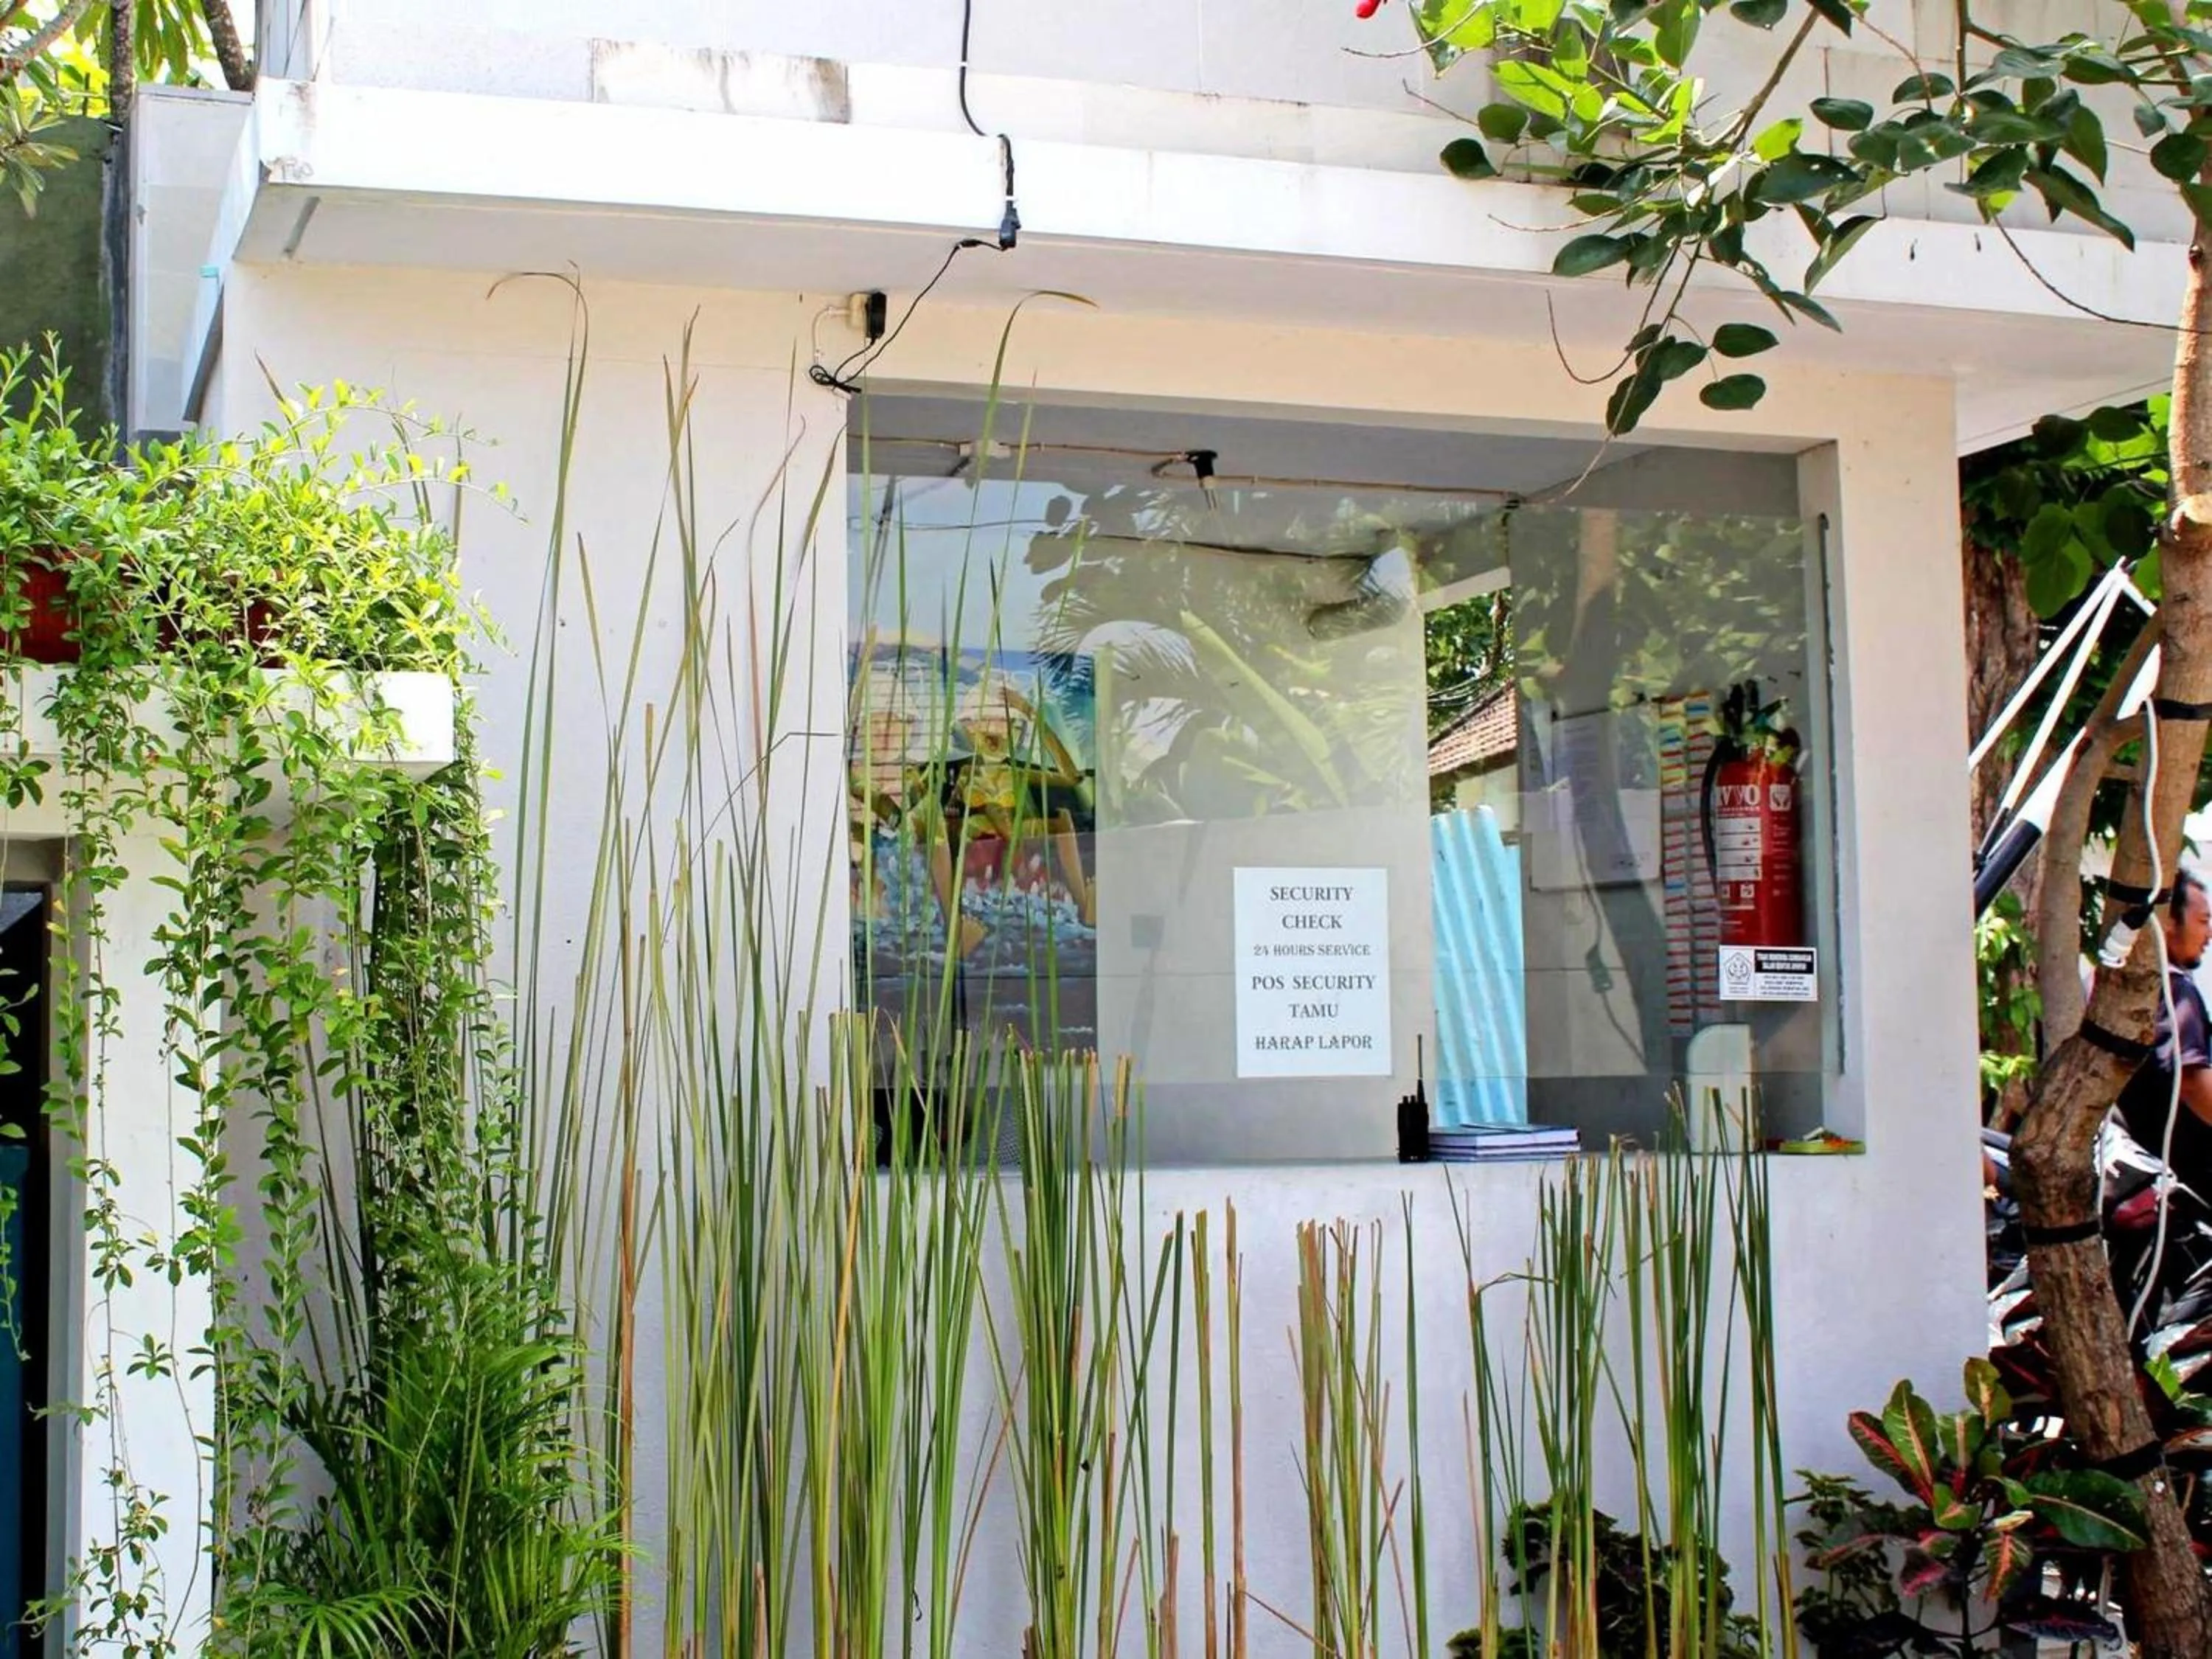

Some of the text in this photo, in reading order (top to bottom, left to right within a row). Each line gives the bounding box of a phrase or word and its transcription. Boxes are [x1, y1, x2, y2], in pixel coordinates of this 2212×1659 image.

[1270, 886, 1354, 901] SECURITY
[1281, 914, 1343, 929] CHECK
[1253, 944, 1371, 956] 24 HOURS SERVICE
[1252, 975, 1377, 990] POS SECURITY
[1289, 1004, 1339, 1018] TAMU
[1256, 1034, 1372, 1050] HARAP LAPOR
